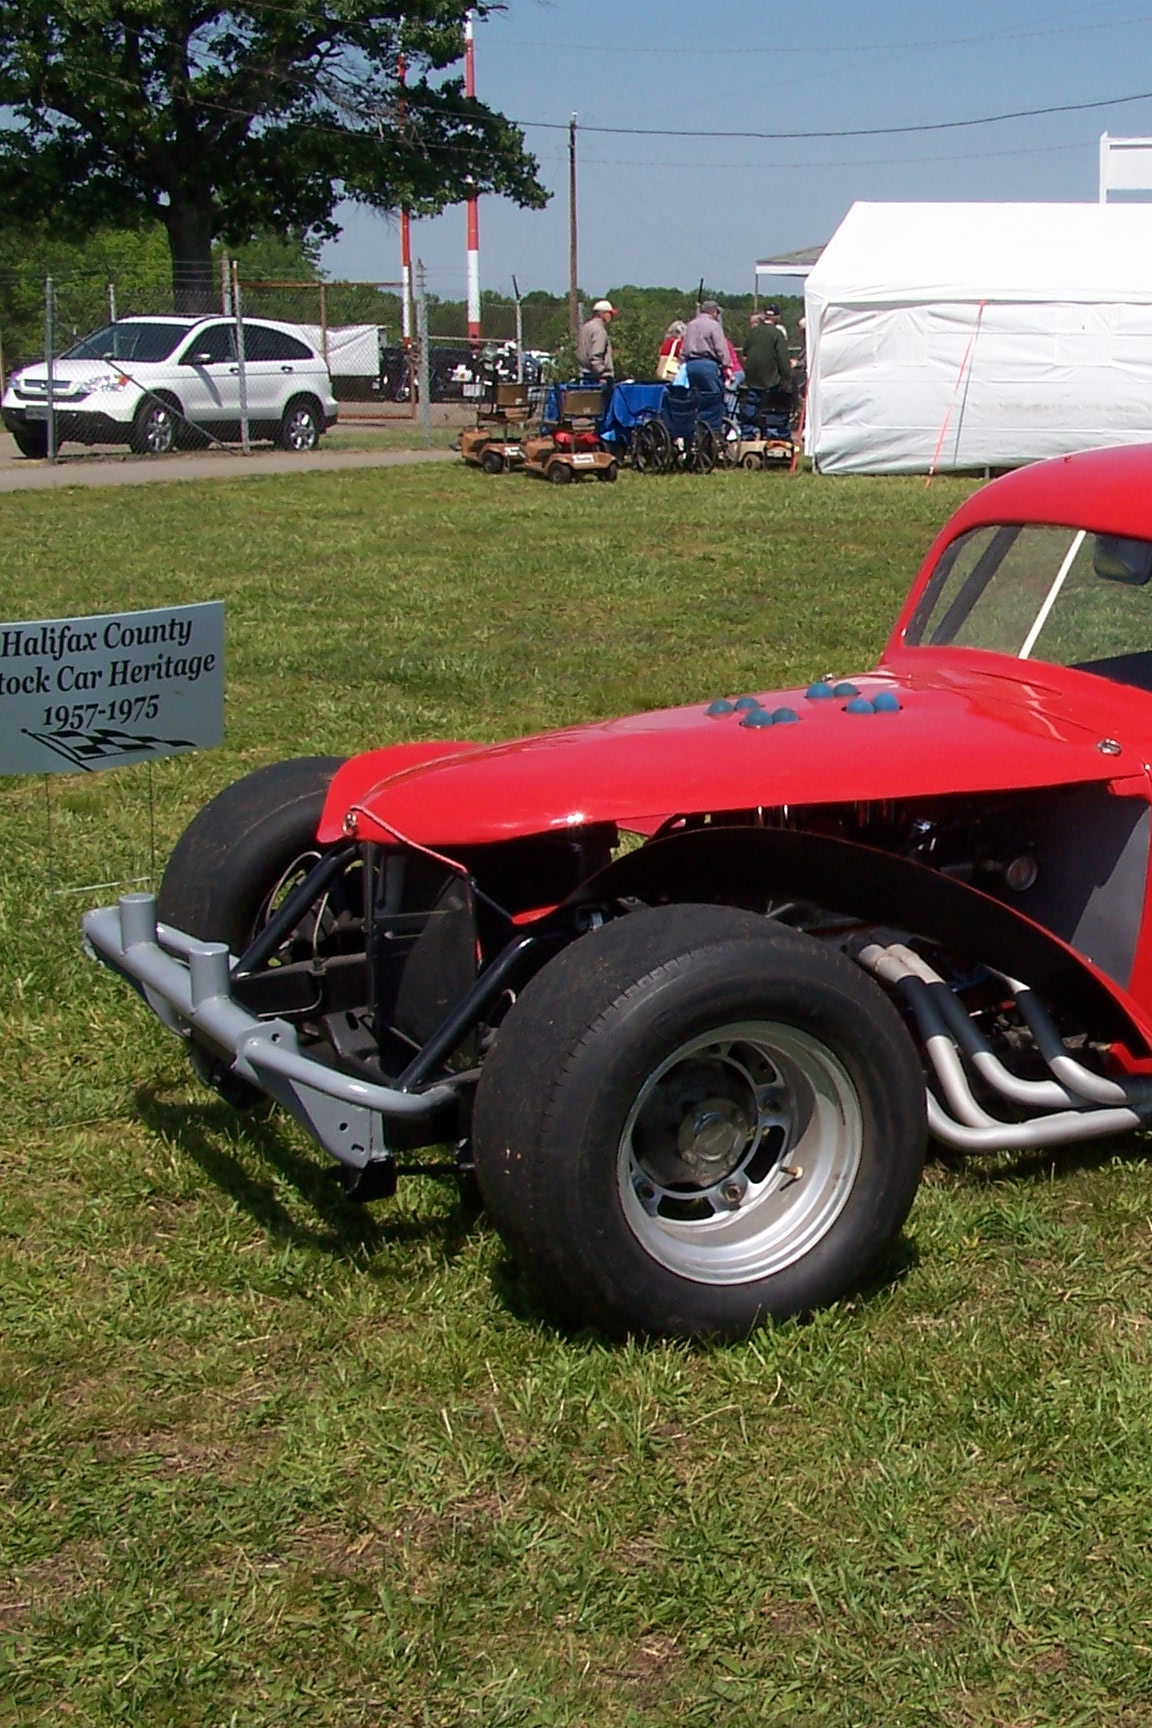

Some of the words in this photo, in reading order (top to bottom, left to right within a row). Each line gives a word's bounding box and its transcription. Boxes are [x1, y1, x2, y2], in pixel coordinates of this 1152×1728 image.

[1, 625, 97, 661] Halifax
[104, 618, 193, 649] County
[57, 665, 104, 692] Car
[109, 653, 216, 688] Heritage
[42, 694, 160, 731] 1957-1975
